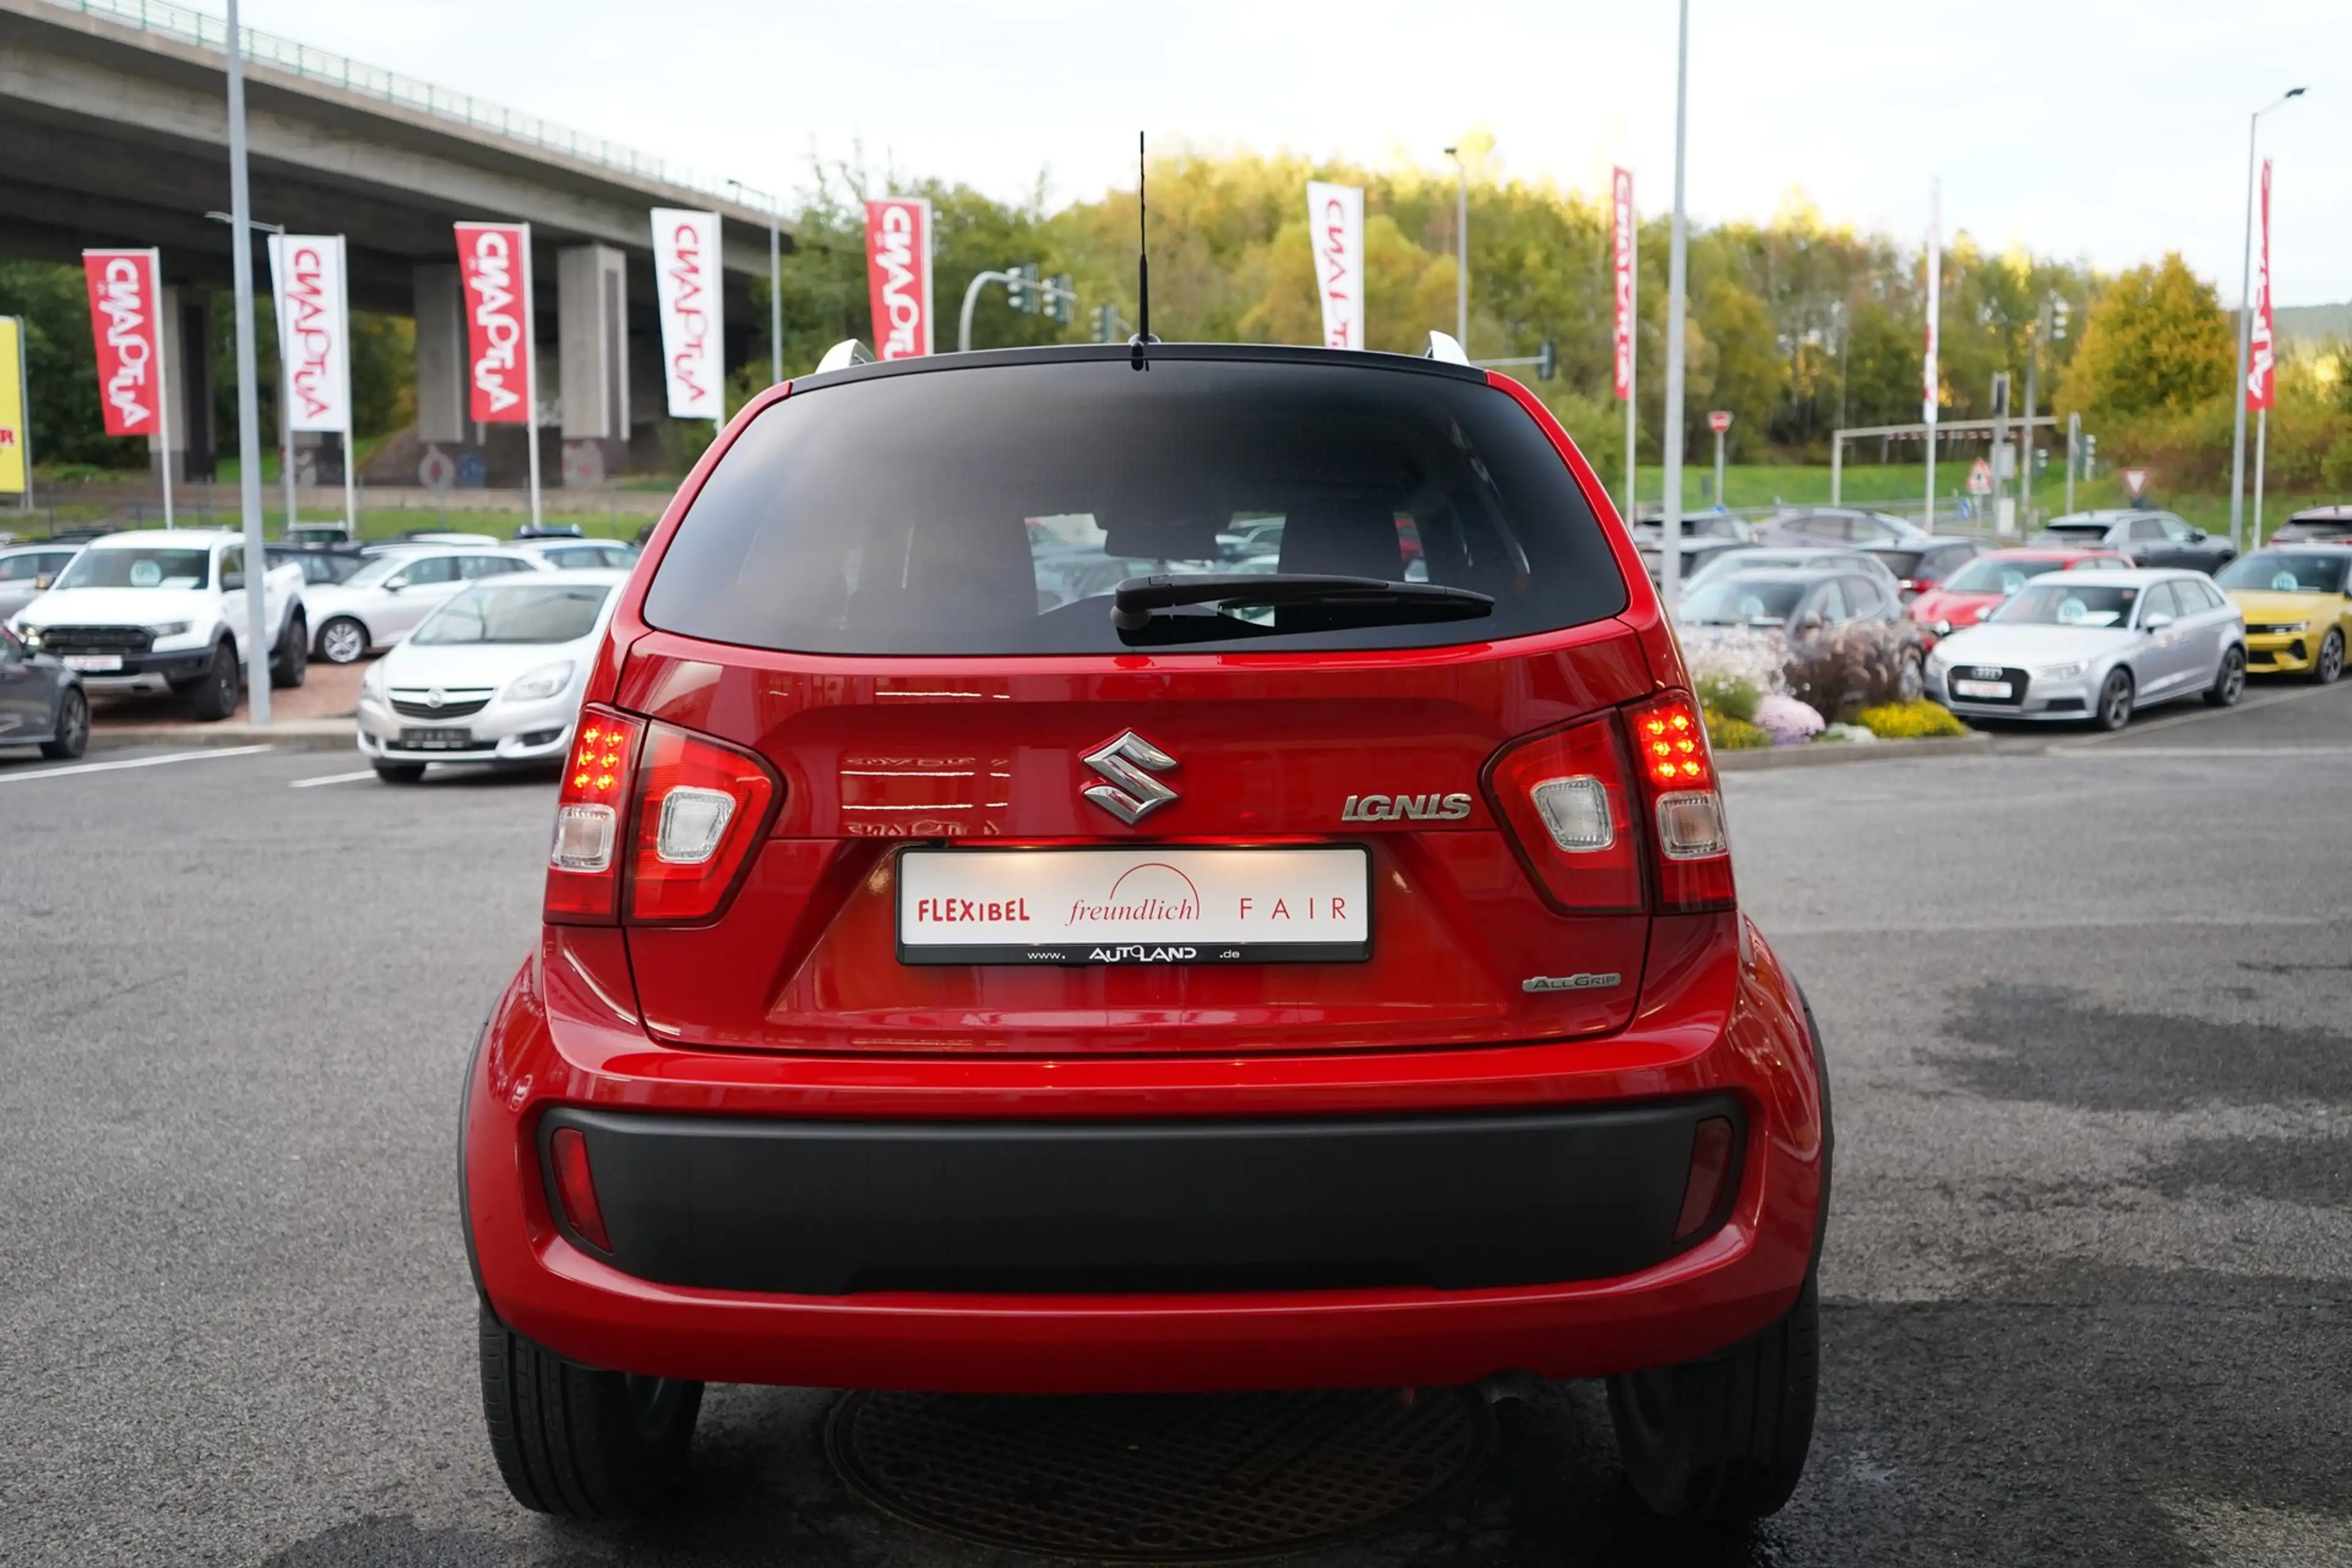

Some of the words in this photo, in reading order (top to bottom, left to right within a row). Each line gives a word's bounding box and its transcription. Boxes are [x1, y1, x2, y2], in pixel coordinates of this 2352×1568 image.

[1341, 793, 1472, 821] IGNIS
[918, 897, 1030, 922] FLEXIBEL
[1065, 898, 1193, 926] freundlich
[1088, 946, 1197, 963] AUTOLAND
[1219, 949, 1241, 959] .de
